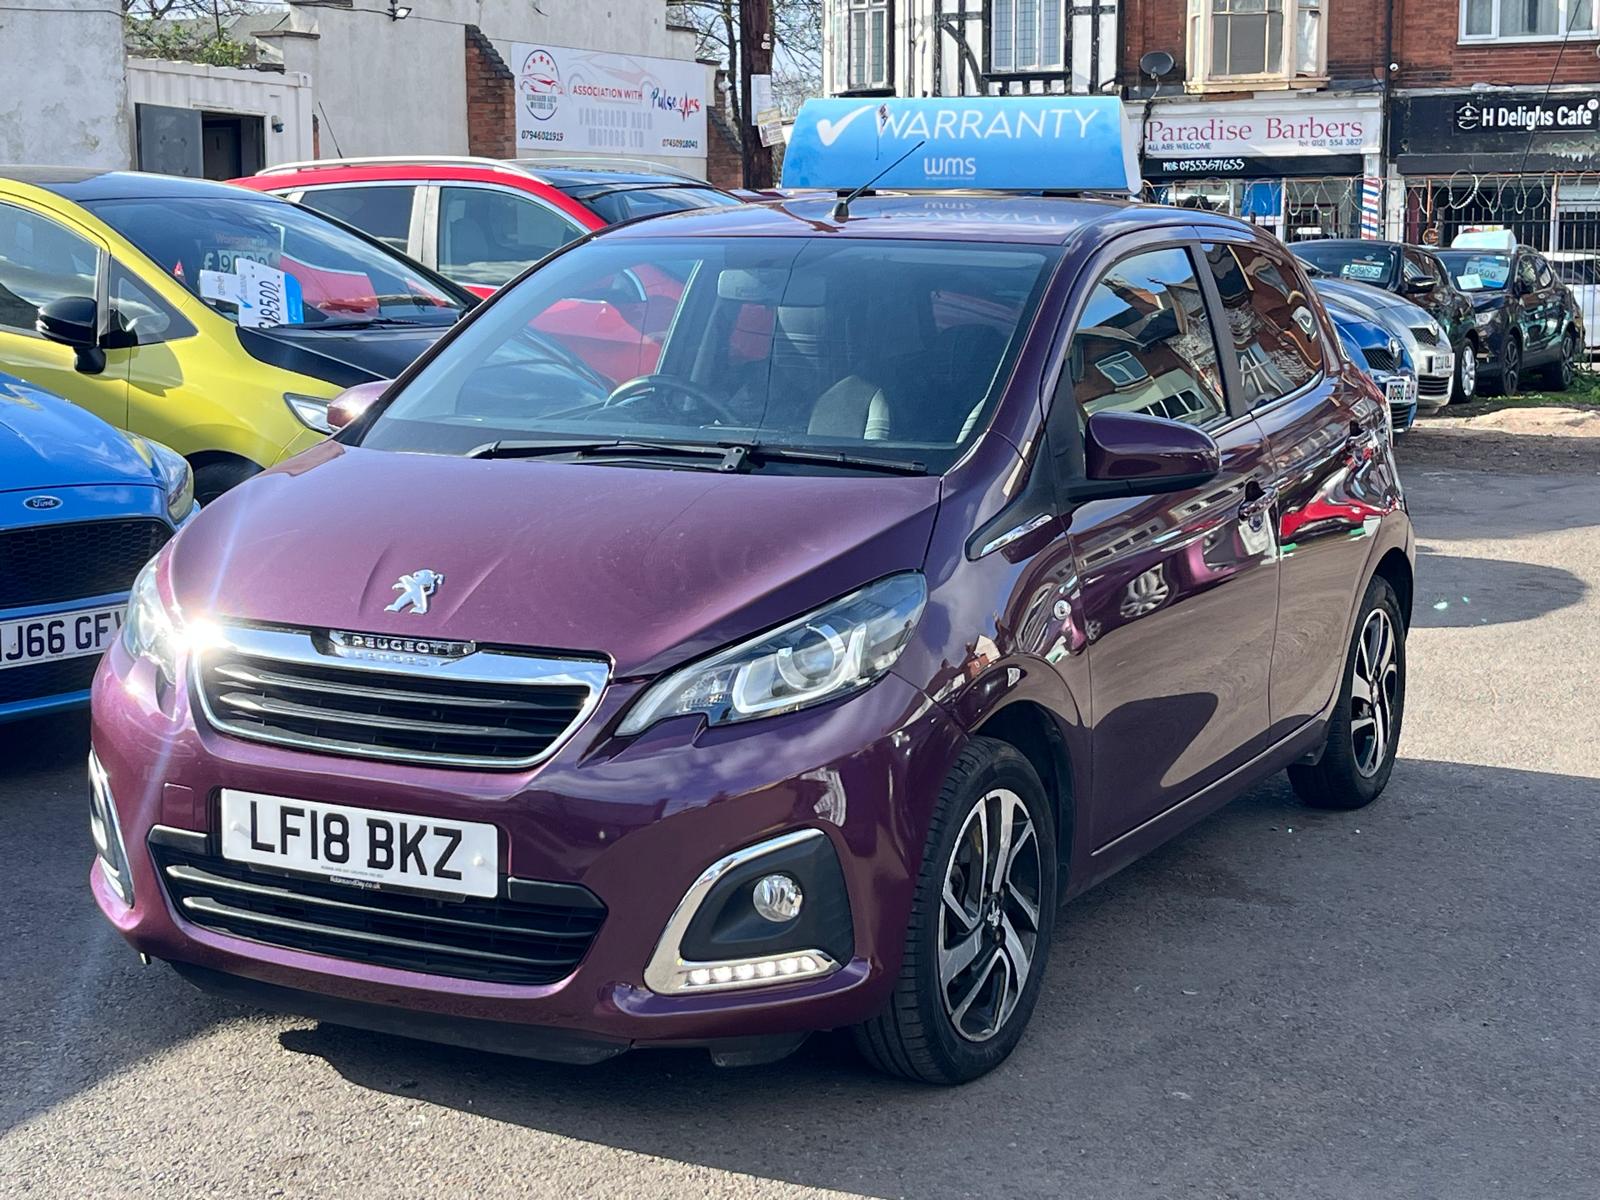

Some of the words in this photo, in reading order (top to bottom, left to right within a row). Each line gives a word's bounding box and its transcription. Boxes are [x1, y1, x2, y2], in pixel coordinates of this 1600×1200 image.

[573, 86, 622, 98] ASSOCIATION
[624, 90, 643, 100] WITH
[651, 87, 676, 110] Pulse
[875, 109, 1100, 139] WARRANTY
[1482, 108, 1494, 126] H
[1147, 119, 1252, 142] Paradise
[1266, 116, 1363, 139] Barbers
[1161, 143, 1174, 151] ARE
[1176, 142, 1211, 151] WELCOME
[924, 157, 977, 175] wms
[0, 620, 65, 661] J66
[352, 635, 441, 655] PEUGEOT
[250, 800, 350, 864] LF18
[366, 817, 463, 881] BKZ
